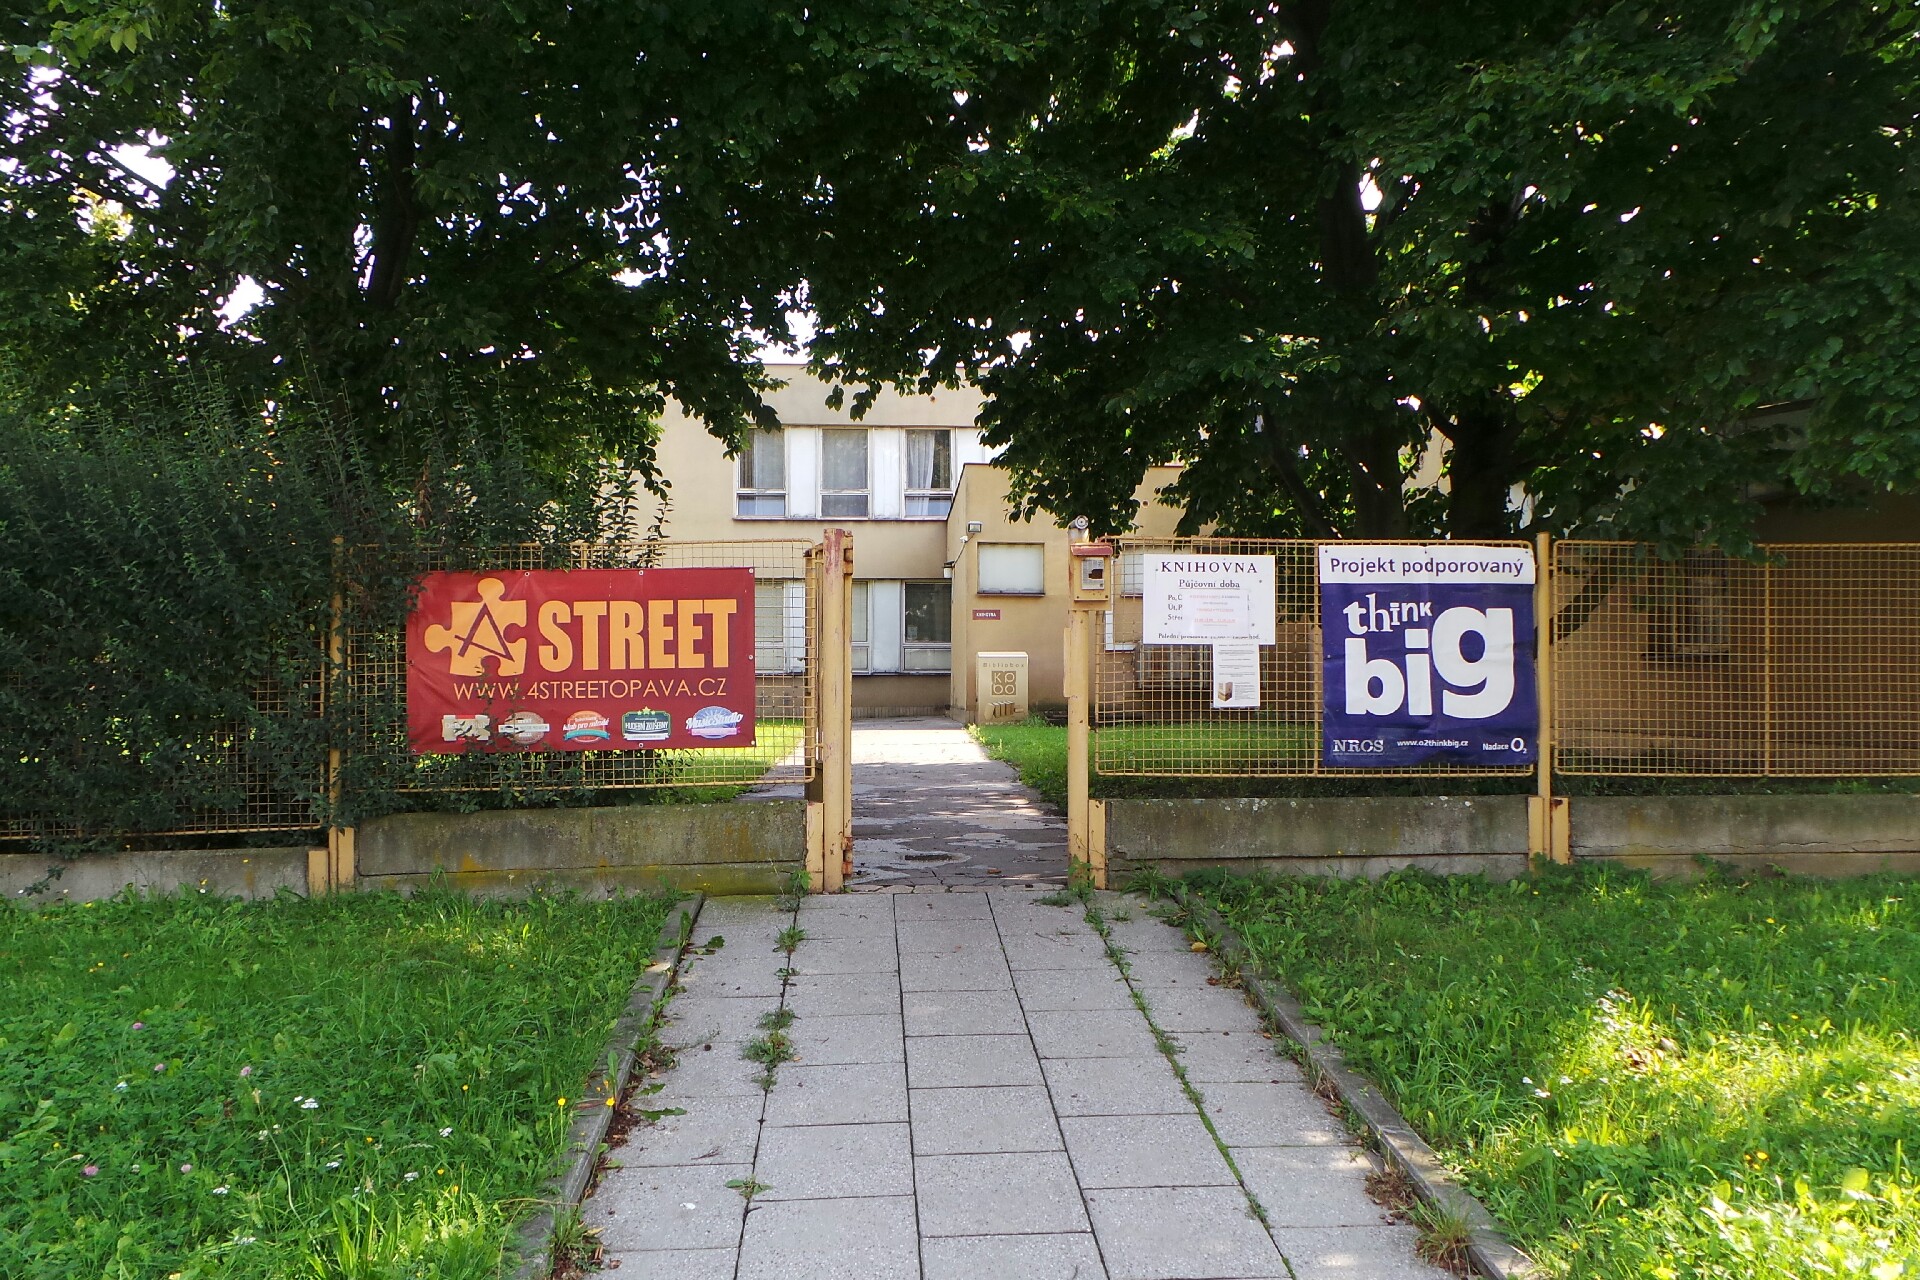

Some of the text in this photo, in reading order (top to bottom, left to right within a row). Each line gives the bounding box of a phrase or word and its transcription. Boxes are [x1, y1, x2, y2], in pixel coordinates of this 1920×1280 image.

[1161, 561, 1258, 574] KNIHOVNA
[1331, 557, 1524, 577] Projekt podporovaný
[1219, 579, 1240, 588] doba
[1343, 593, 1433, 635] think
[538, 598, 738, 673] STREET
[1344, 606, 1515, 719] big
[453, 677, 727, 700] WWW.4STREETOPAVA.CZ
[685, 711, 744, 730] MusicStudio
[1396, 738, 1469, 749] www.o2thinkbig.cz
[1482, 741, 1509, 751] Nadace
